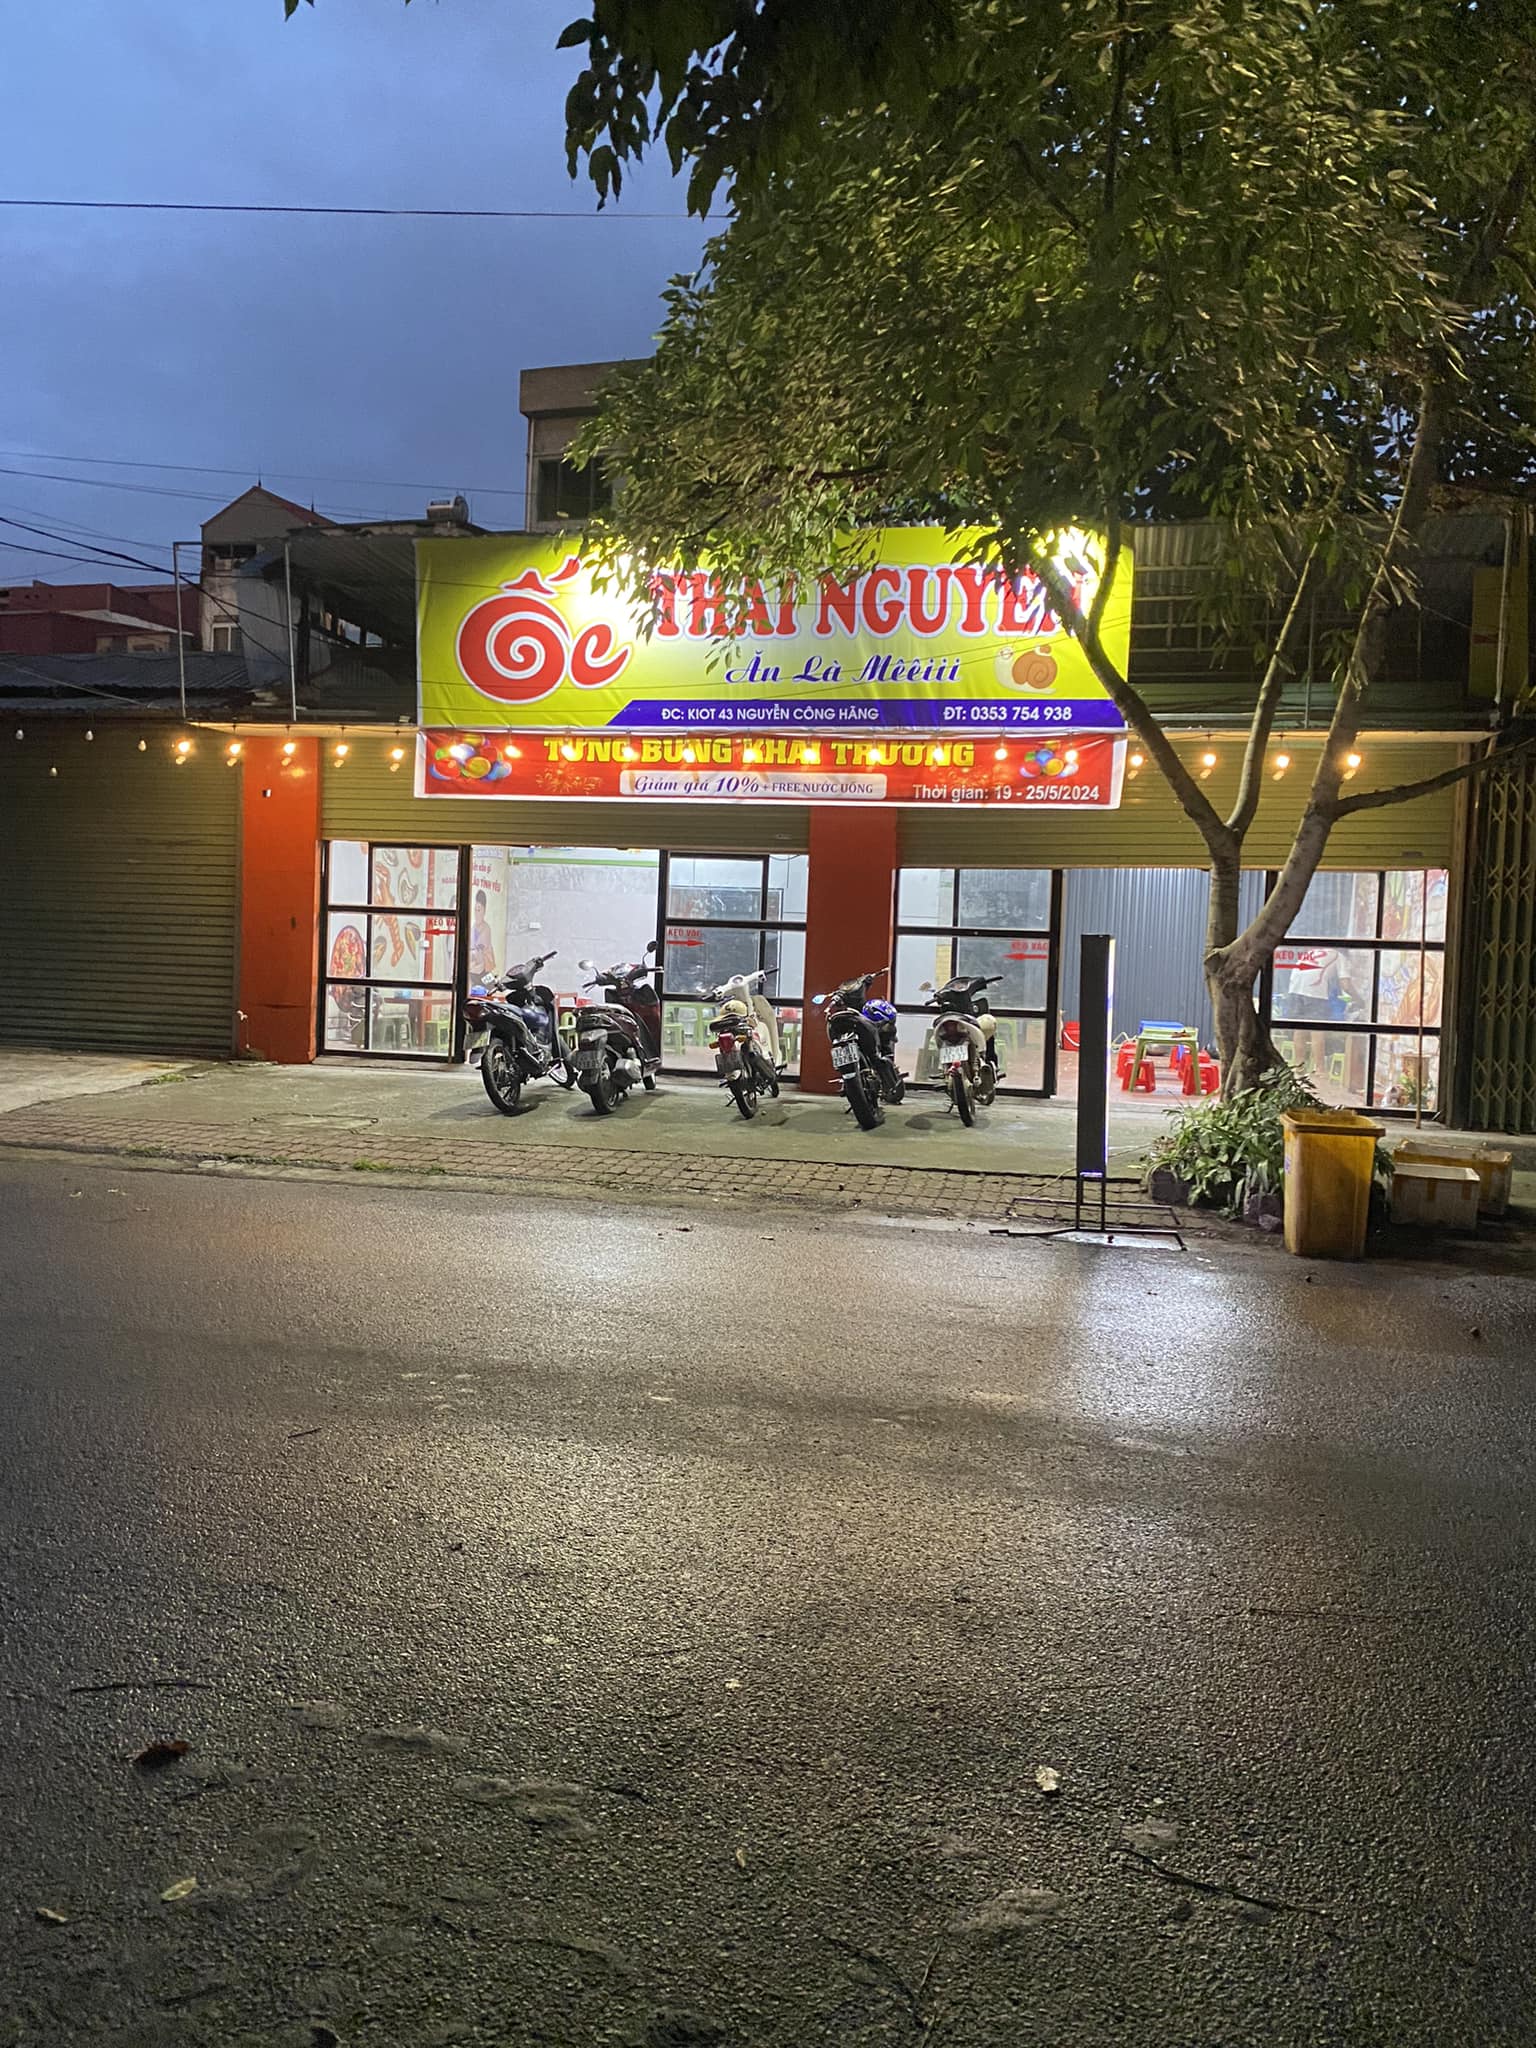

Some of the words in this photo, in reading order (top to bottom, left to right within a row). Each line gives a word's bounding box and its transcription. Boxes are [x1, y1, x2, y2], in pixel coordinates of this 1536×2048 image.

[725, 649, 783, 683] Ăn
[792, 655, 845, 683] Là
[661, 708, 684, 720] ĐC:
[687, 708, 716, 720] KIOT
[718, 708, 733, 720] 43
[736, 704, 790, 721] NGUYỄN
[793, 705, 836, 721] CÔNG
[943, 707, 966, 721] ĐT:
[970, 706, 1007, 721] 0353
[1012, 706, 1040, 721] 754
[1043, 706, 1073, 721] 938
[716, 776, 759, 793] 10%
[772, 783, 801, 792] FREE
[951, 784, 989, 803] gian:
[994, 785, 1012, 800] 19
[1026, 785, 1100, 800] 25/5/2024
